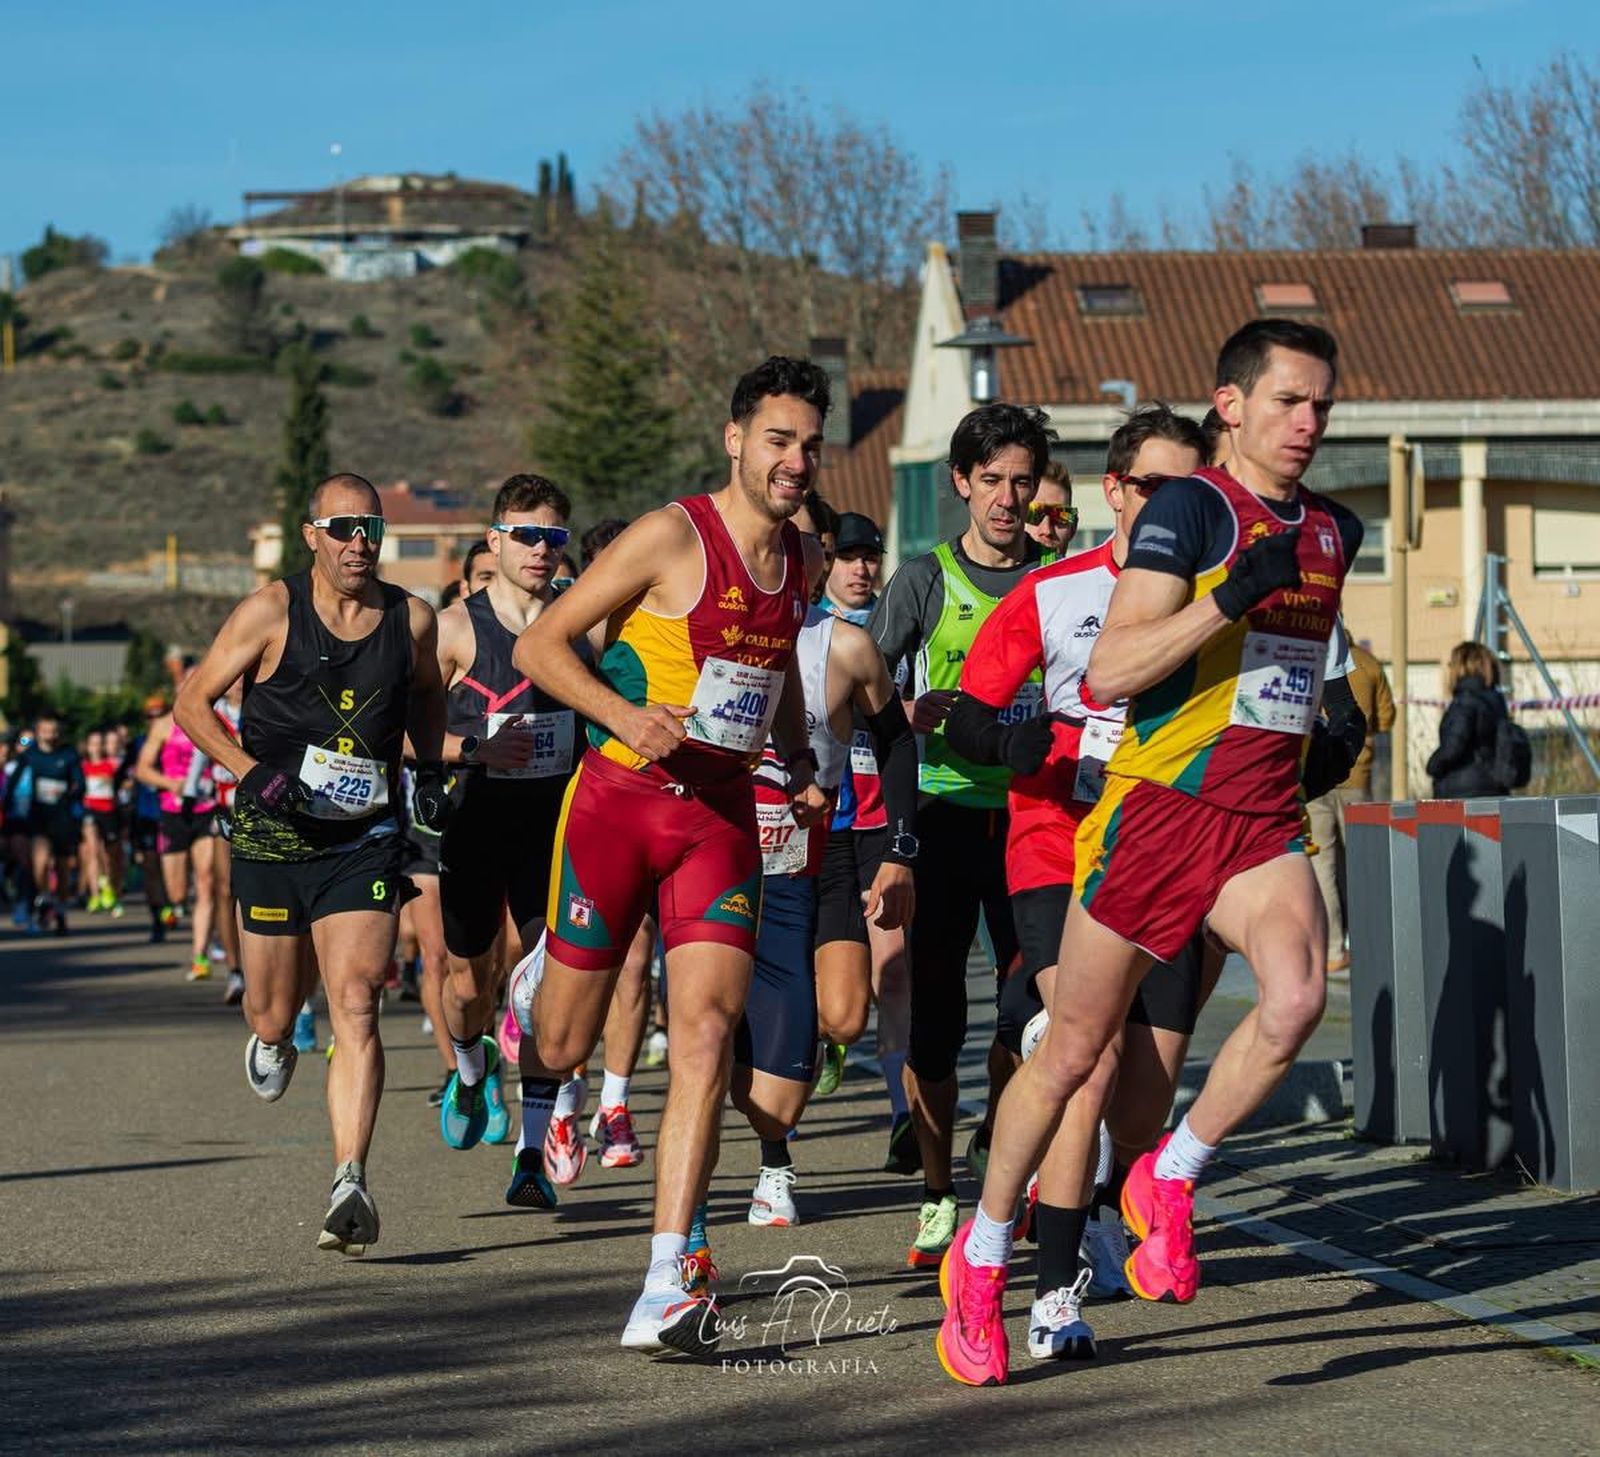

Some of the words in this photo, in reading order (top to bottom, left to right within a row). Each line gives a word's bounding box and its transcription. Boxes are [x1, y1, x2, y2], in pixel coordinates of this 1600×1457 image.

[1282, 591, 1322, 609] VINO
[1287, 666, 1315, 694] 451
[340, 689, 354, 710] S
[737, 691, 769, 717] 400
[999, 703, 1032, 723] 491
[337, 737, 354, 758] R
[337, 775, 372, 798] 225
